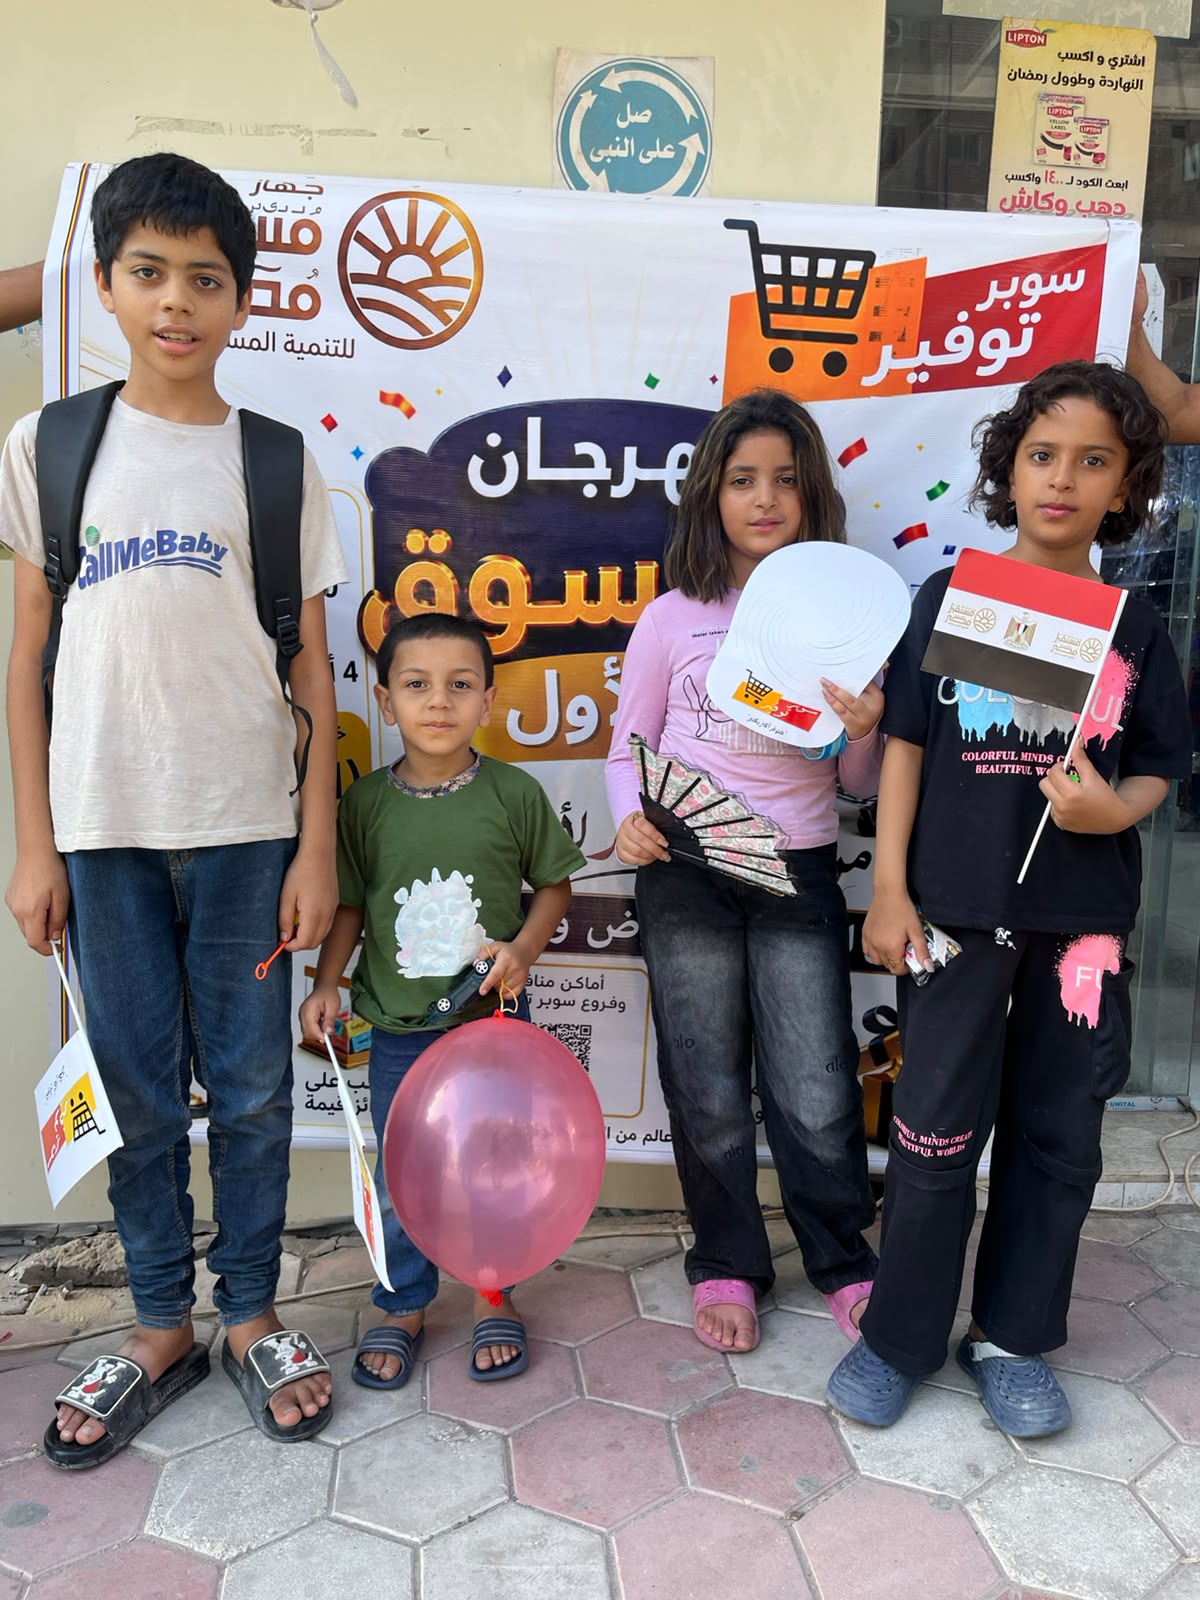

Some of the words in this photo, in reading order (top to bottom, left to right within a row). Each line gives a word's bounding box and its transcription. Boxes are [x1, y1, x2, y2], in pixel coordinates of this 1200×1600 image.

[1006, 32, 1046, 45] LIPTON
[1057, 51, 1094, 62] اكسب
[1097, 55, 1105, 65] و
[1108, 56, 1146, 70] اشتري
[1007, 68, 1048, 84] رمضان
[1051, 72, 1095, 88] وطوول
[1099, 75, 1144, 92] النهاردة
[616, 102, 652, 129] صل
[1048, 107, 1073, 116] LIPTON
[1080, 126, 1102, 134] LIPTON
[638, 137, 676, 164] على
[1005, 173, 1041, 185] واكسب
[1076, 174, 1103, 188] الكود
[1105, 177, 1128, 190] ابعت
[249, 179, 324, 200] جهاز
[999, 187, 1068, 216] وكاش
[1075, 199, 1126, 218] دهب
[976, 268, 1086, 311] سوبر
[284, 333, 355, 360] للتنمية
[861, 311, 1041, 387] توفير
[467, 416, 697, 506] هرجان
[343, 660, 359, 683] 4
[961, 751, 1018, 761] COLORFUL
[1021, 752, 1054, 764] MINDS
[975, 764, 1032, 775] BEAUTIFUL
[561, 974, 605, 992] أماكن
[537, 997, 576, 1011] سوبر
[581, 996, 626, 1013] وفروع
[616, 1131, 637, 1143] من
[919, 1135, 950, 1147] MINDS
[936, 1143, 967, 1157] WORLDS
